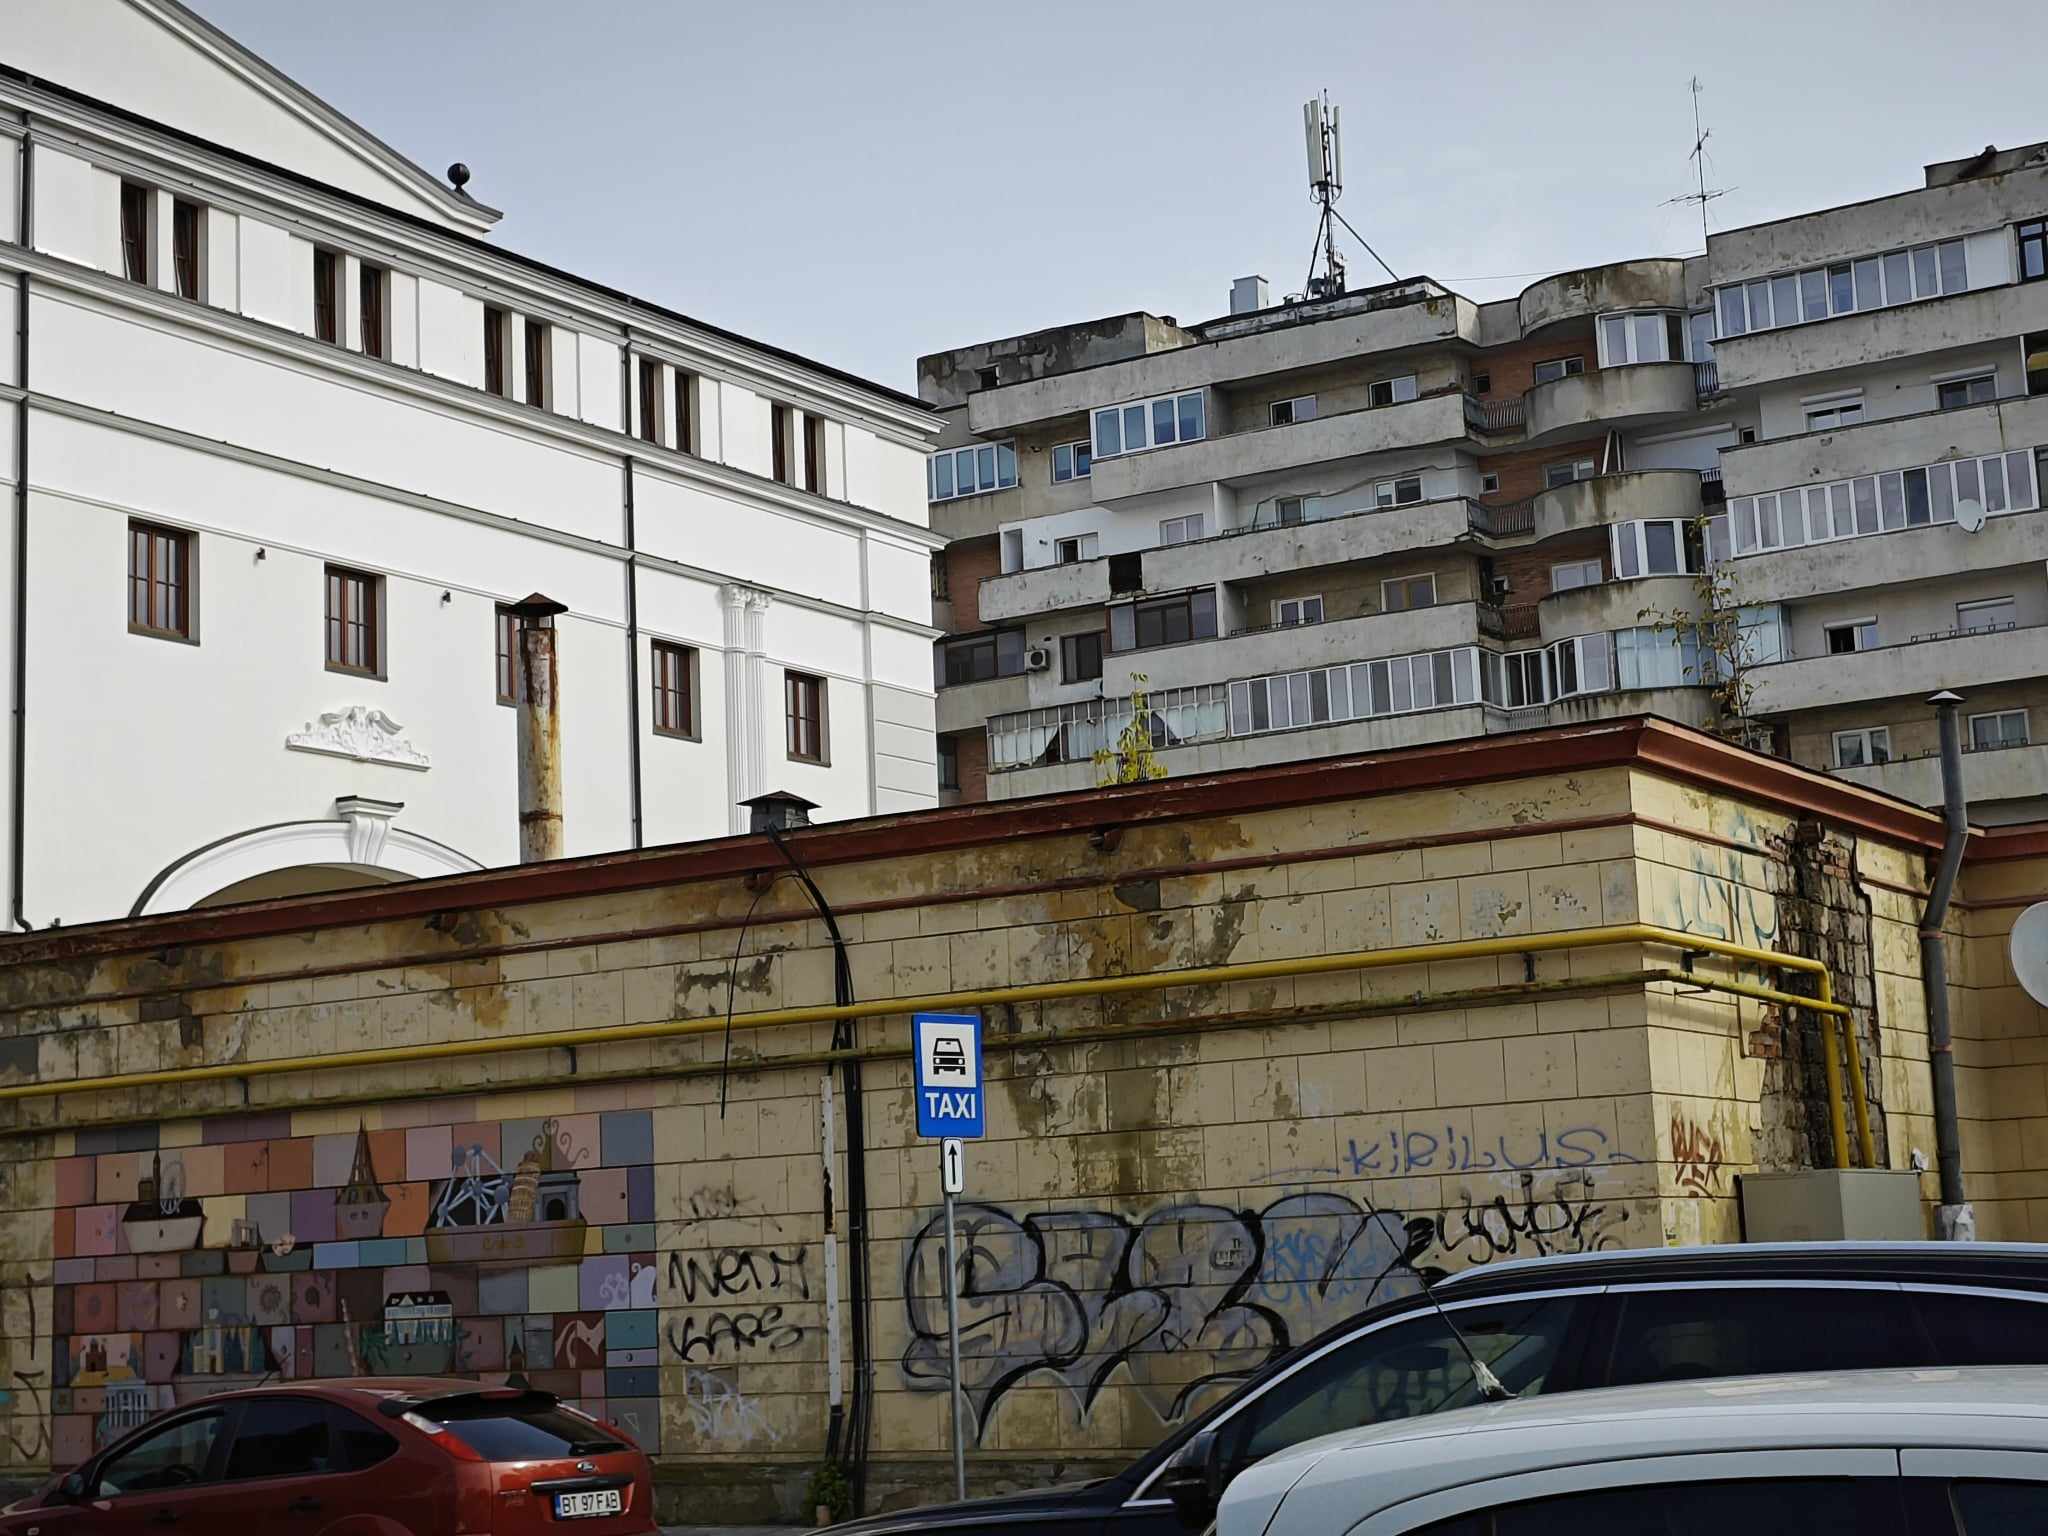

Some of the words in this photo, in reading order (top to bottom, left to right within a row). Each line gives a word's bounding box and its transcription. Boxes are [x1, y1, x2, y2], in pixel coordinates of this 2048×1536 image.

[924, 1091, 977, 1120] TAXI
[562, 1496, 577, 1514] BT
[581, 1494, 594, 1512] 97
